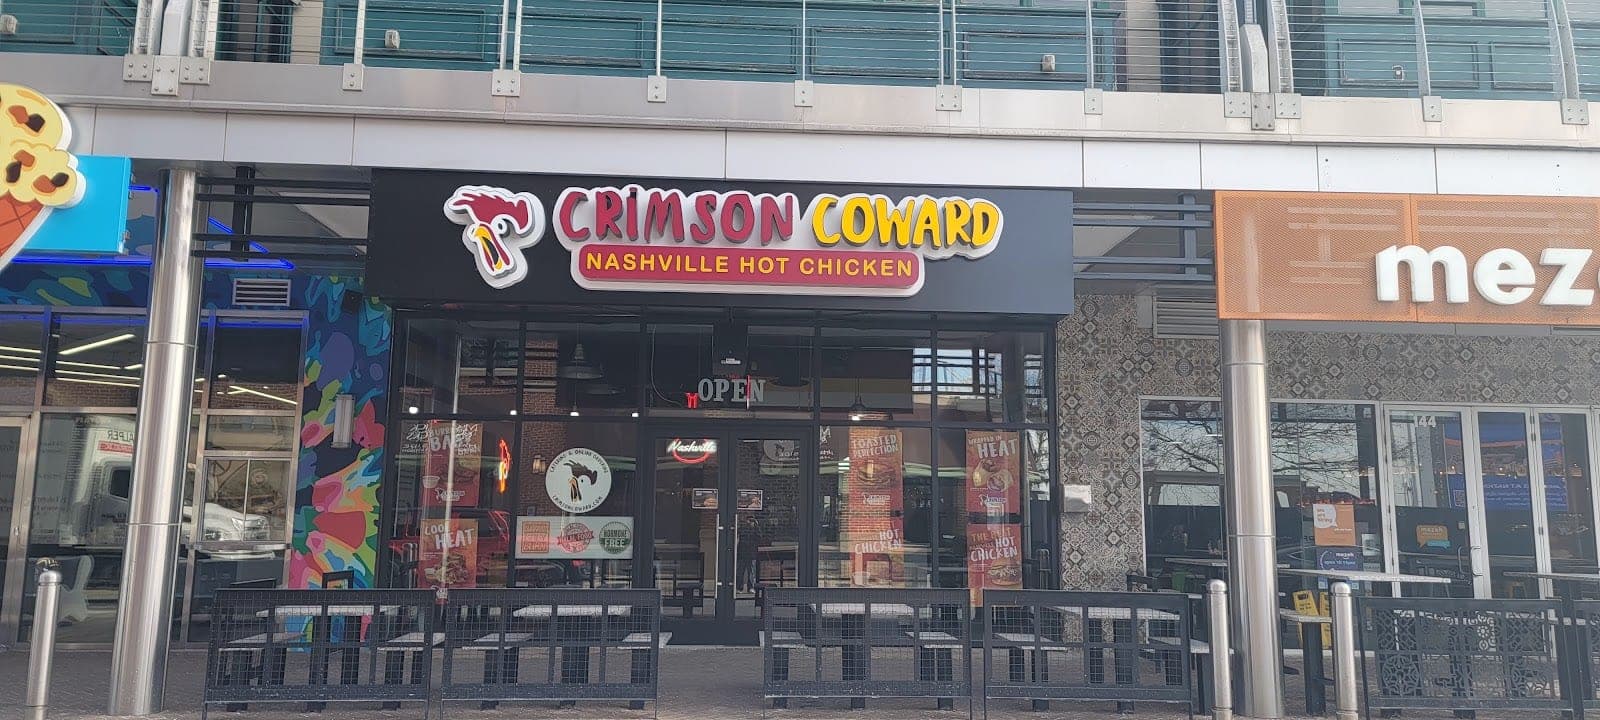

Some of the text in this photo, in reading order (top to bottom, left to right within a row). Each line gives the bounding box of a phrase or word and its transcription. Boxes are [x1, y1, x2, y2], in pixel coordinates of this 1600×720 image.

[559, 187, 1000, 249] CRIMSON COWARD
[586, 252, 912, 277] NASHVILLE HOT CHICKEN
[1375, 245, 1600, 306] mez
[698, 378, 766, 402] OPEN
[977, 439, 1017, 459] HEAT
[435, 528, 475, 550] HEAT
[604, 538, 626, 548] FREE
[880, 529, 900, 541] HOT
[996, 536, 1015, 548] HOT
[855, 539, 902, 555] CHICKEN
[971, 546, 1018, 562] CHICKEN
